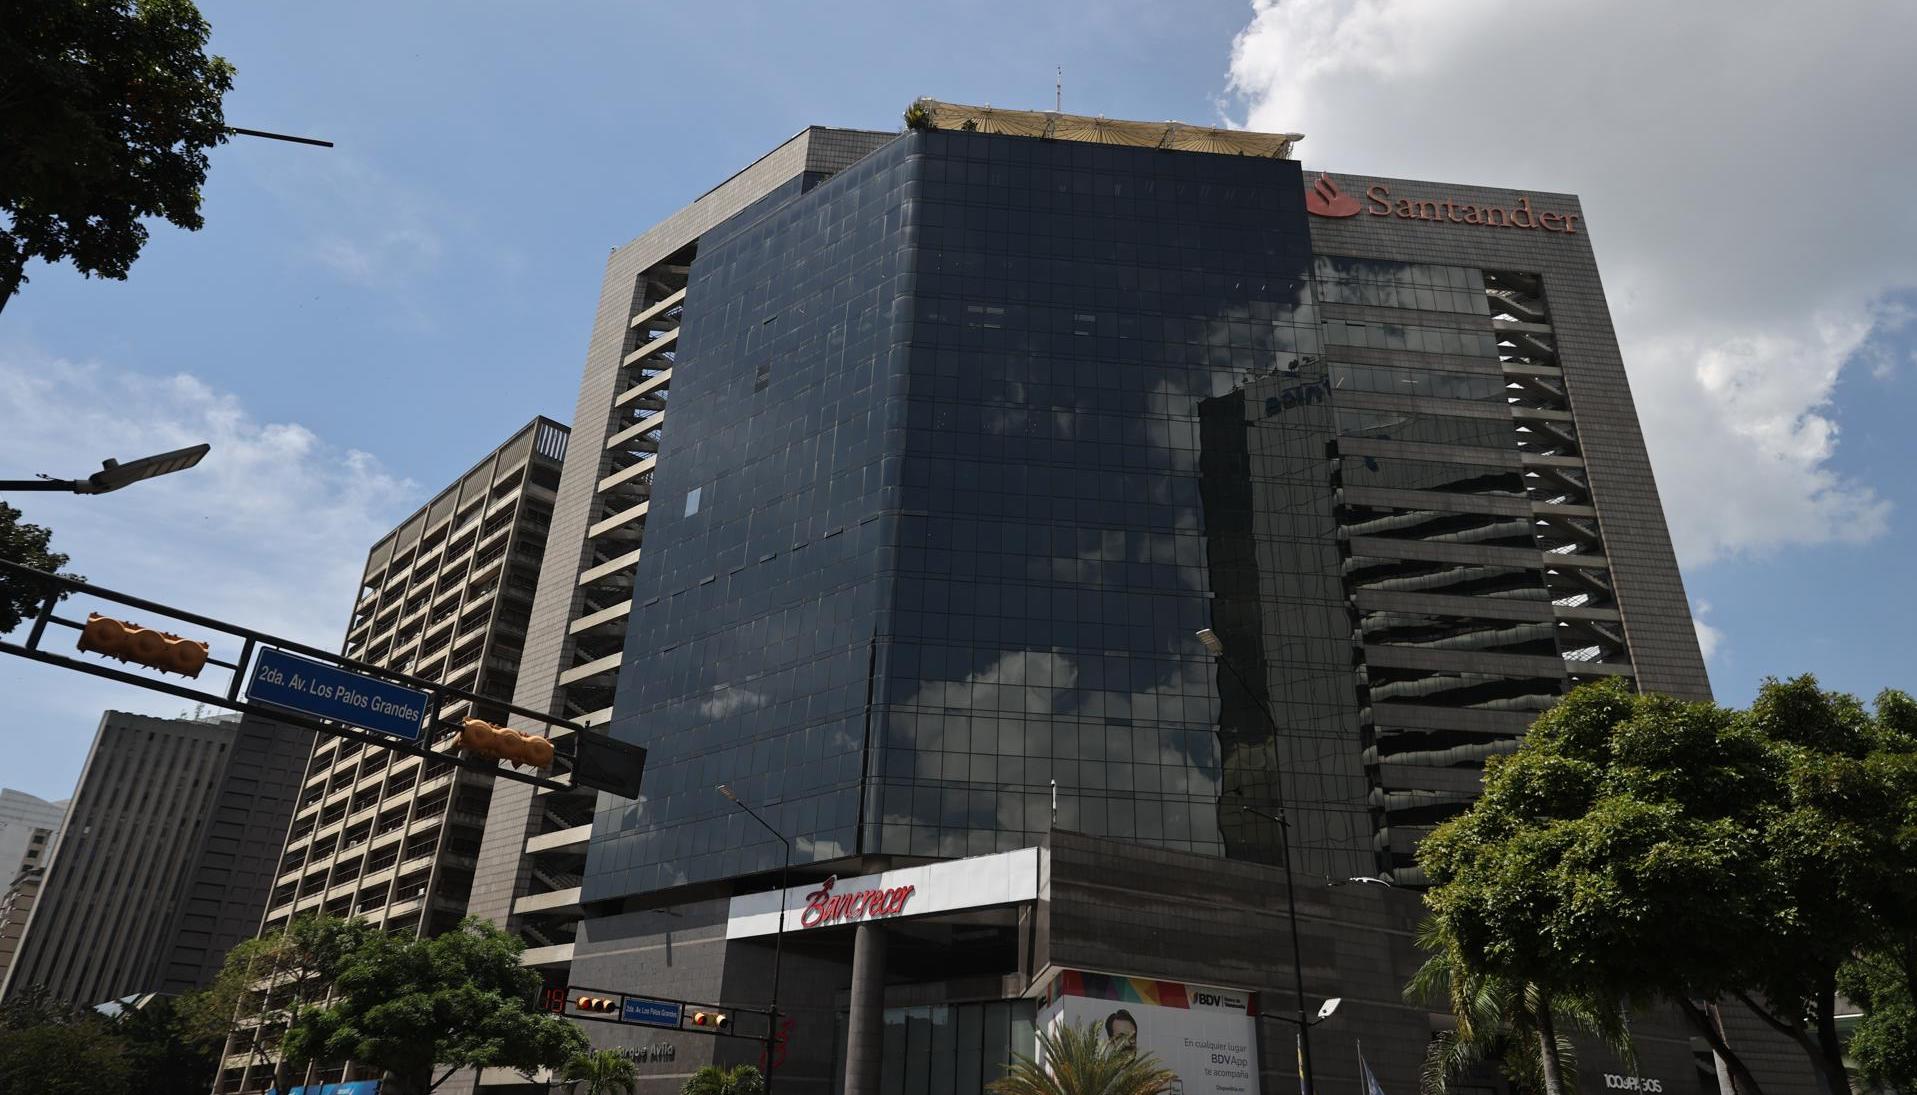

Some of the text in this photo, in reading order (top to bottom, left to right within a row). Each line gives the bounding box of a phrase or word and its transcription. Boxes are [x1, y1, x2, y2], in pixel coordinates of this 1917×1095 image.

[1366, 185, 1578, 233] Santander
[258, 665, 420, 722] 2da. Av. Los Palos Grandes
[801, 874, 915, 928] Bancrecer
[1199, 993, 1220, 1007] BDV
[1184, 1038, 1247, 1053] En cualquier lugar
